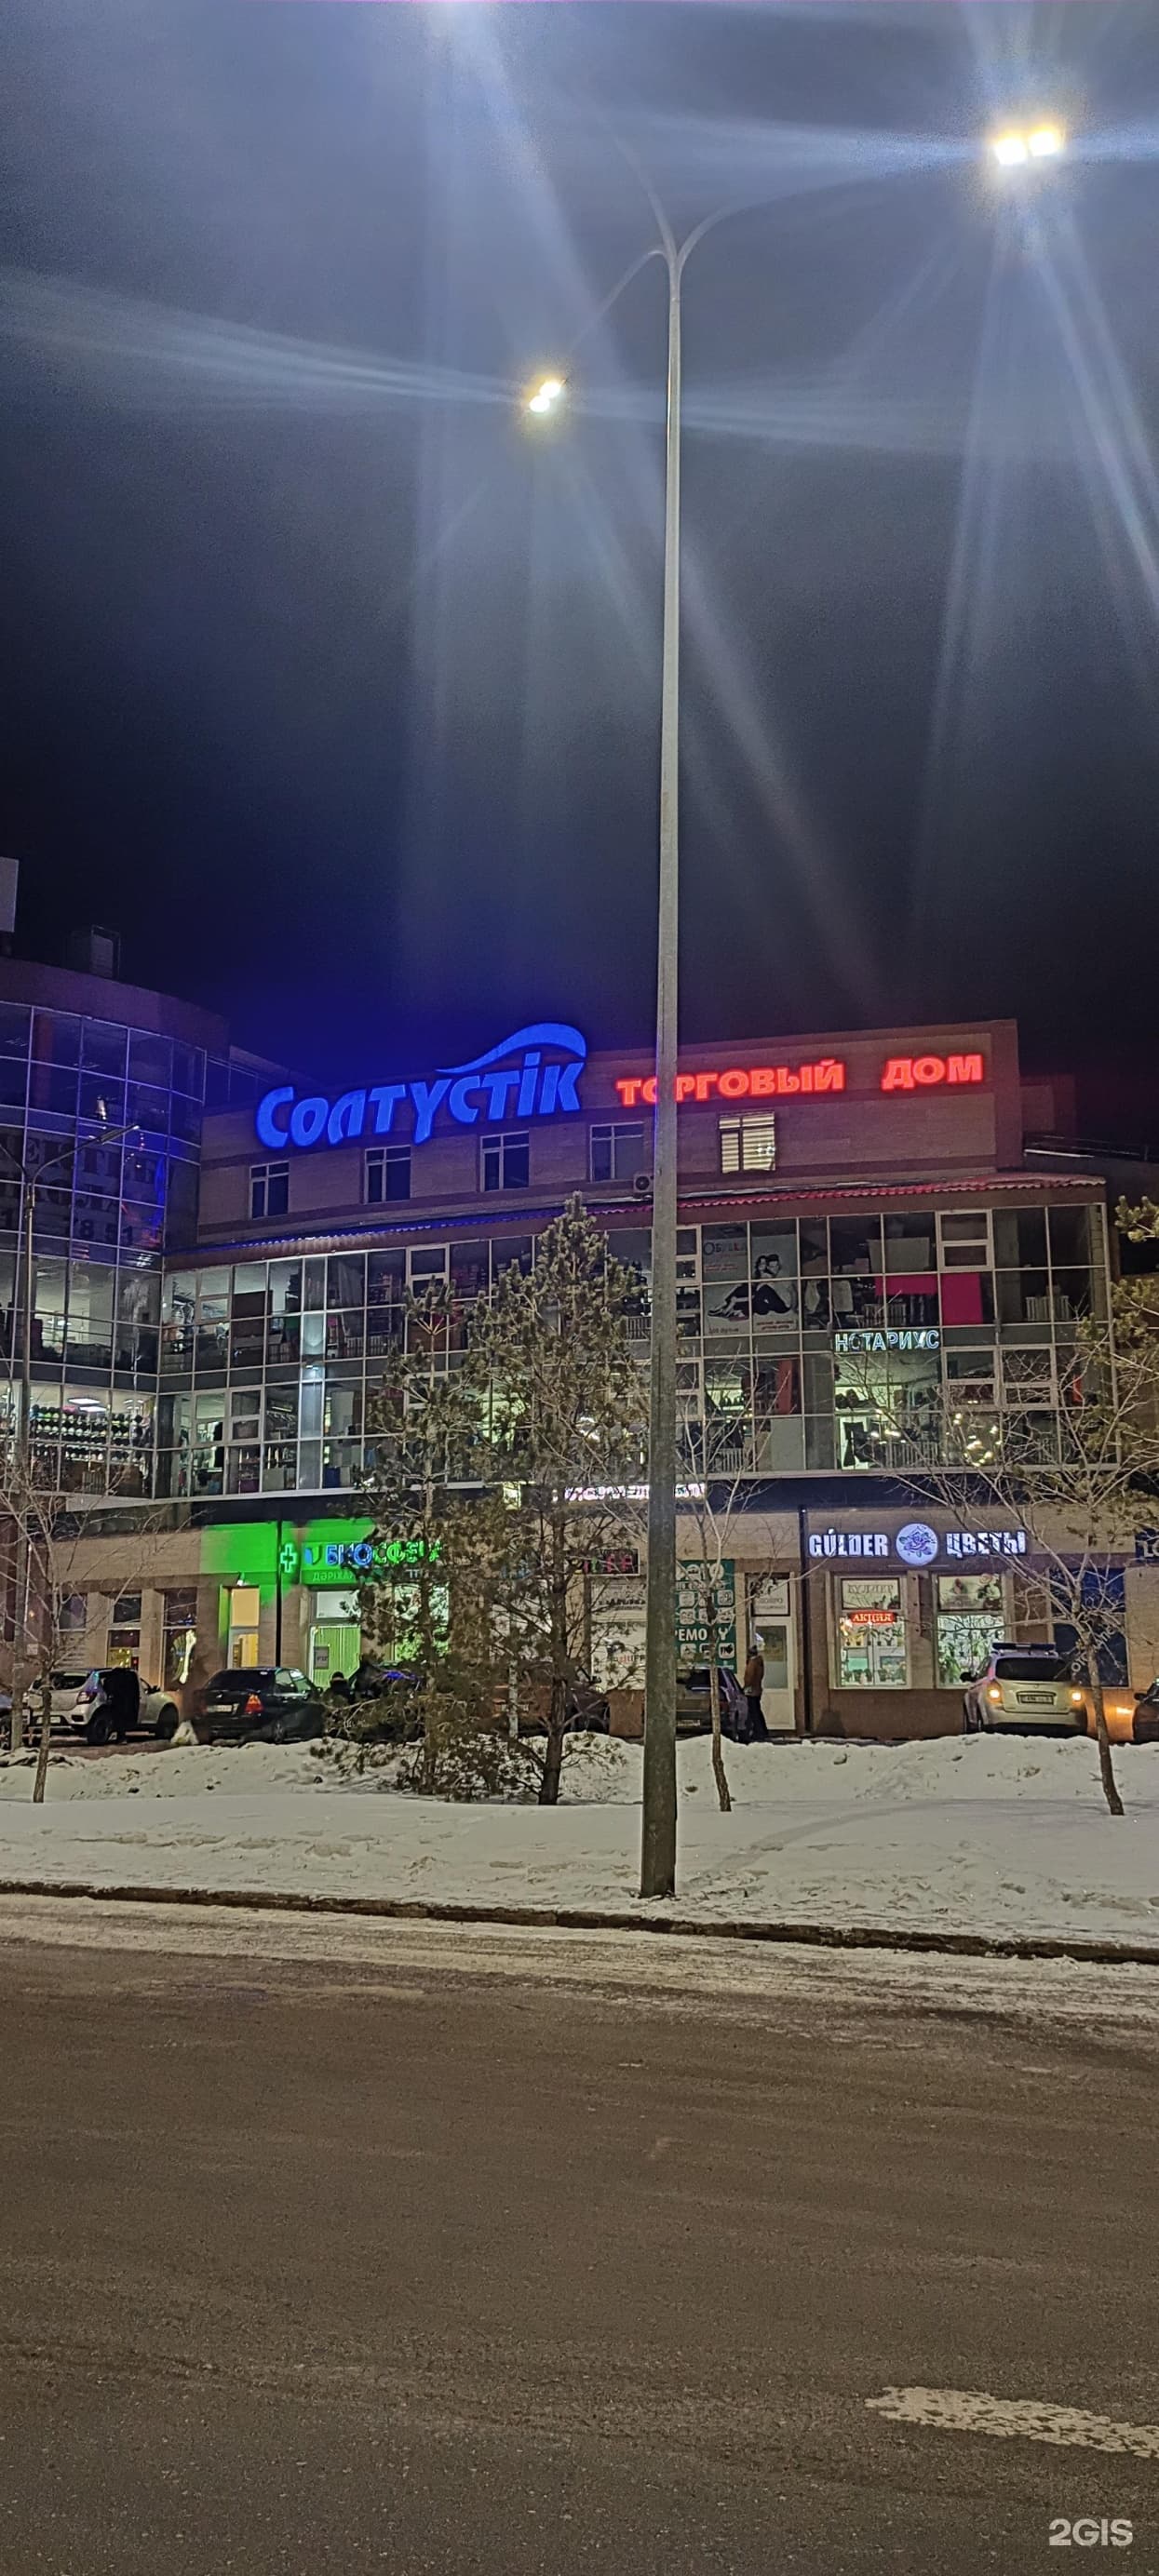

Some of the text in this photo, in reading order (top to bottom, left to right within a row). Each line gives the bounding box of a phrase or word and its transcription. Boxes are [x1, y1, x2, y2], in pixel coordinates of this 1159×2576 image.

[882, 1053, 983, 1091] ДОМ
[834, 1329, 939, 1352] НОТАРИУС
[946, 1531, 1027, 1559] ЦВЕТЫ
[852, 1612, 893, 1623] АКЦИЯ
[675, 1628, 717, 1642] ЕМО
